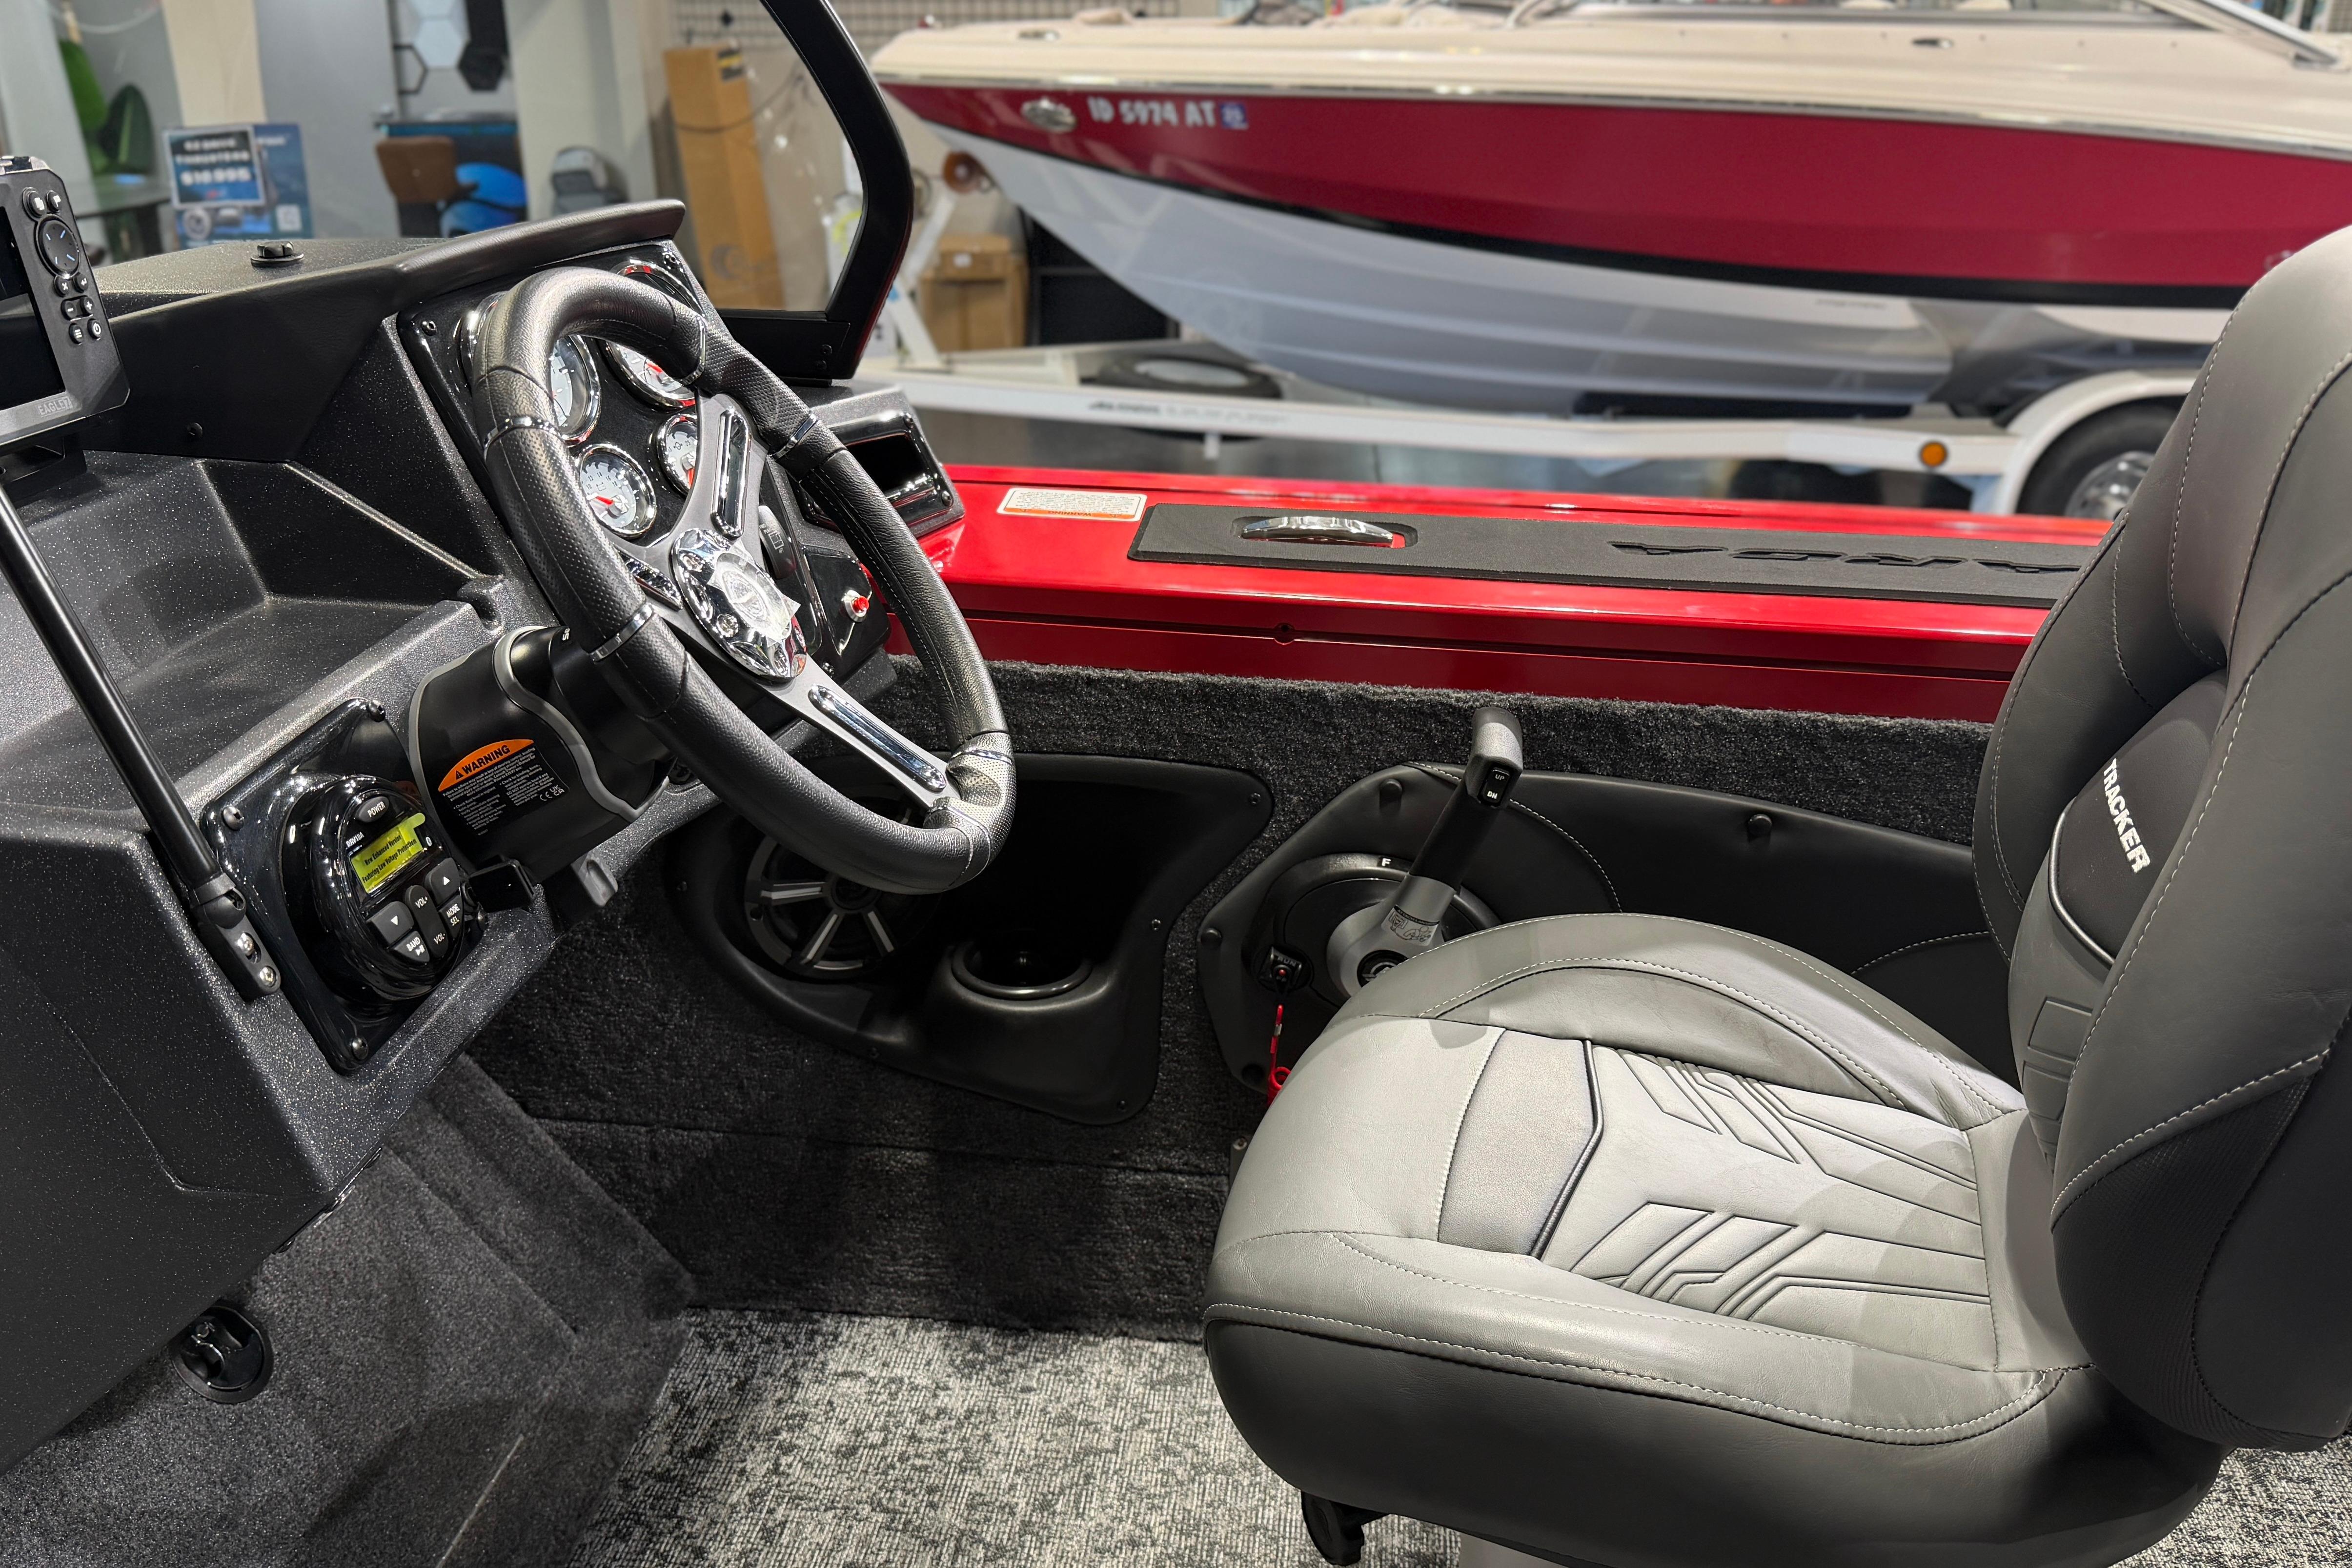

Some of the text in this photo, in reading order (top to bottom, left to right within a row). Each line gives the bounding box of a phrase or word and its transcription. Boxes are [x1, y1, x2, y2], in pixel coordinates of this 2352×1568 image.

[1087, 97, 1115, 122] ID
[1119, 100, 1179, 125] 5974
[1184, 101, 1216, 126] AT
[38, 400, 65, 415] EAGLE
[462, 745, 510, 774] WARNING
[367, 801, 386, 817] POWER
[2104, 757, 2151, 874] TRACKER
[372, 844, 389, 860] Enhanced
[389, 834, 402, 849] Version
[362, 838, 417, 883] Featuring Low Voltage Protection
[1382, 858, 1391, 866] F
[415, 896, 428, 908] VOL+
[446, 904, 460, 917] MODE
[450, 916, 460, 926] SEL
[406, 937, 421, 952] BAND
[1277, 957, 1296, 967] RUN
